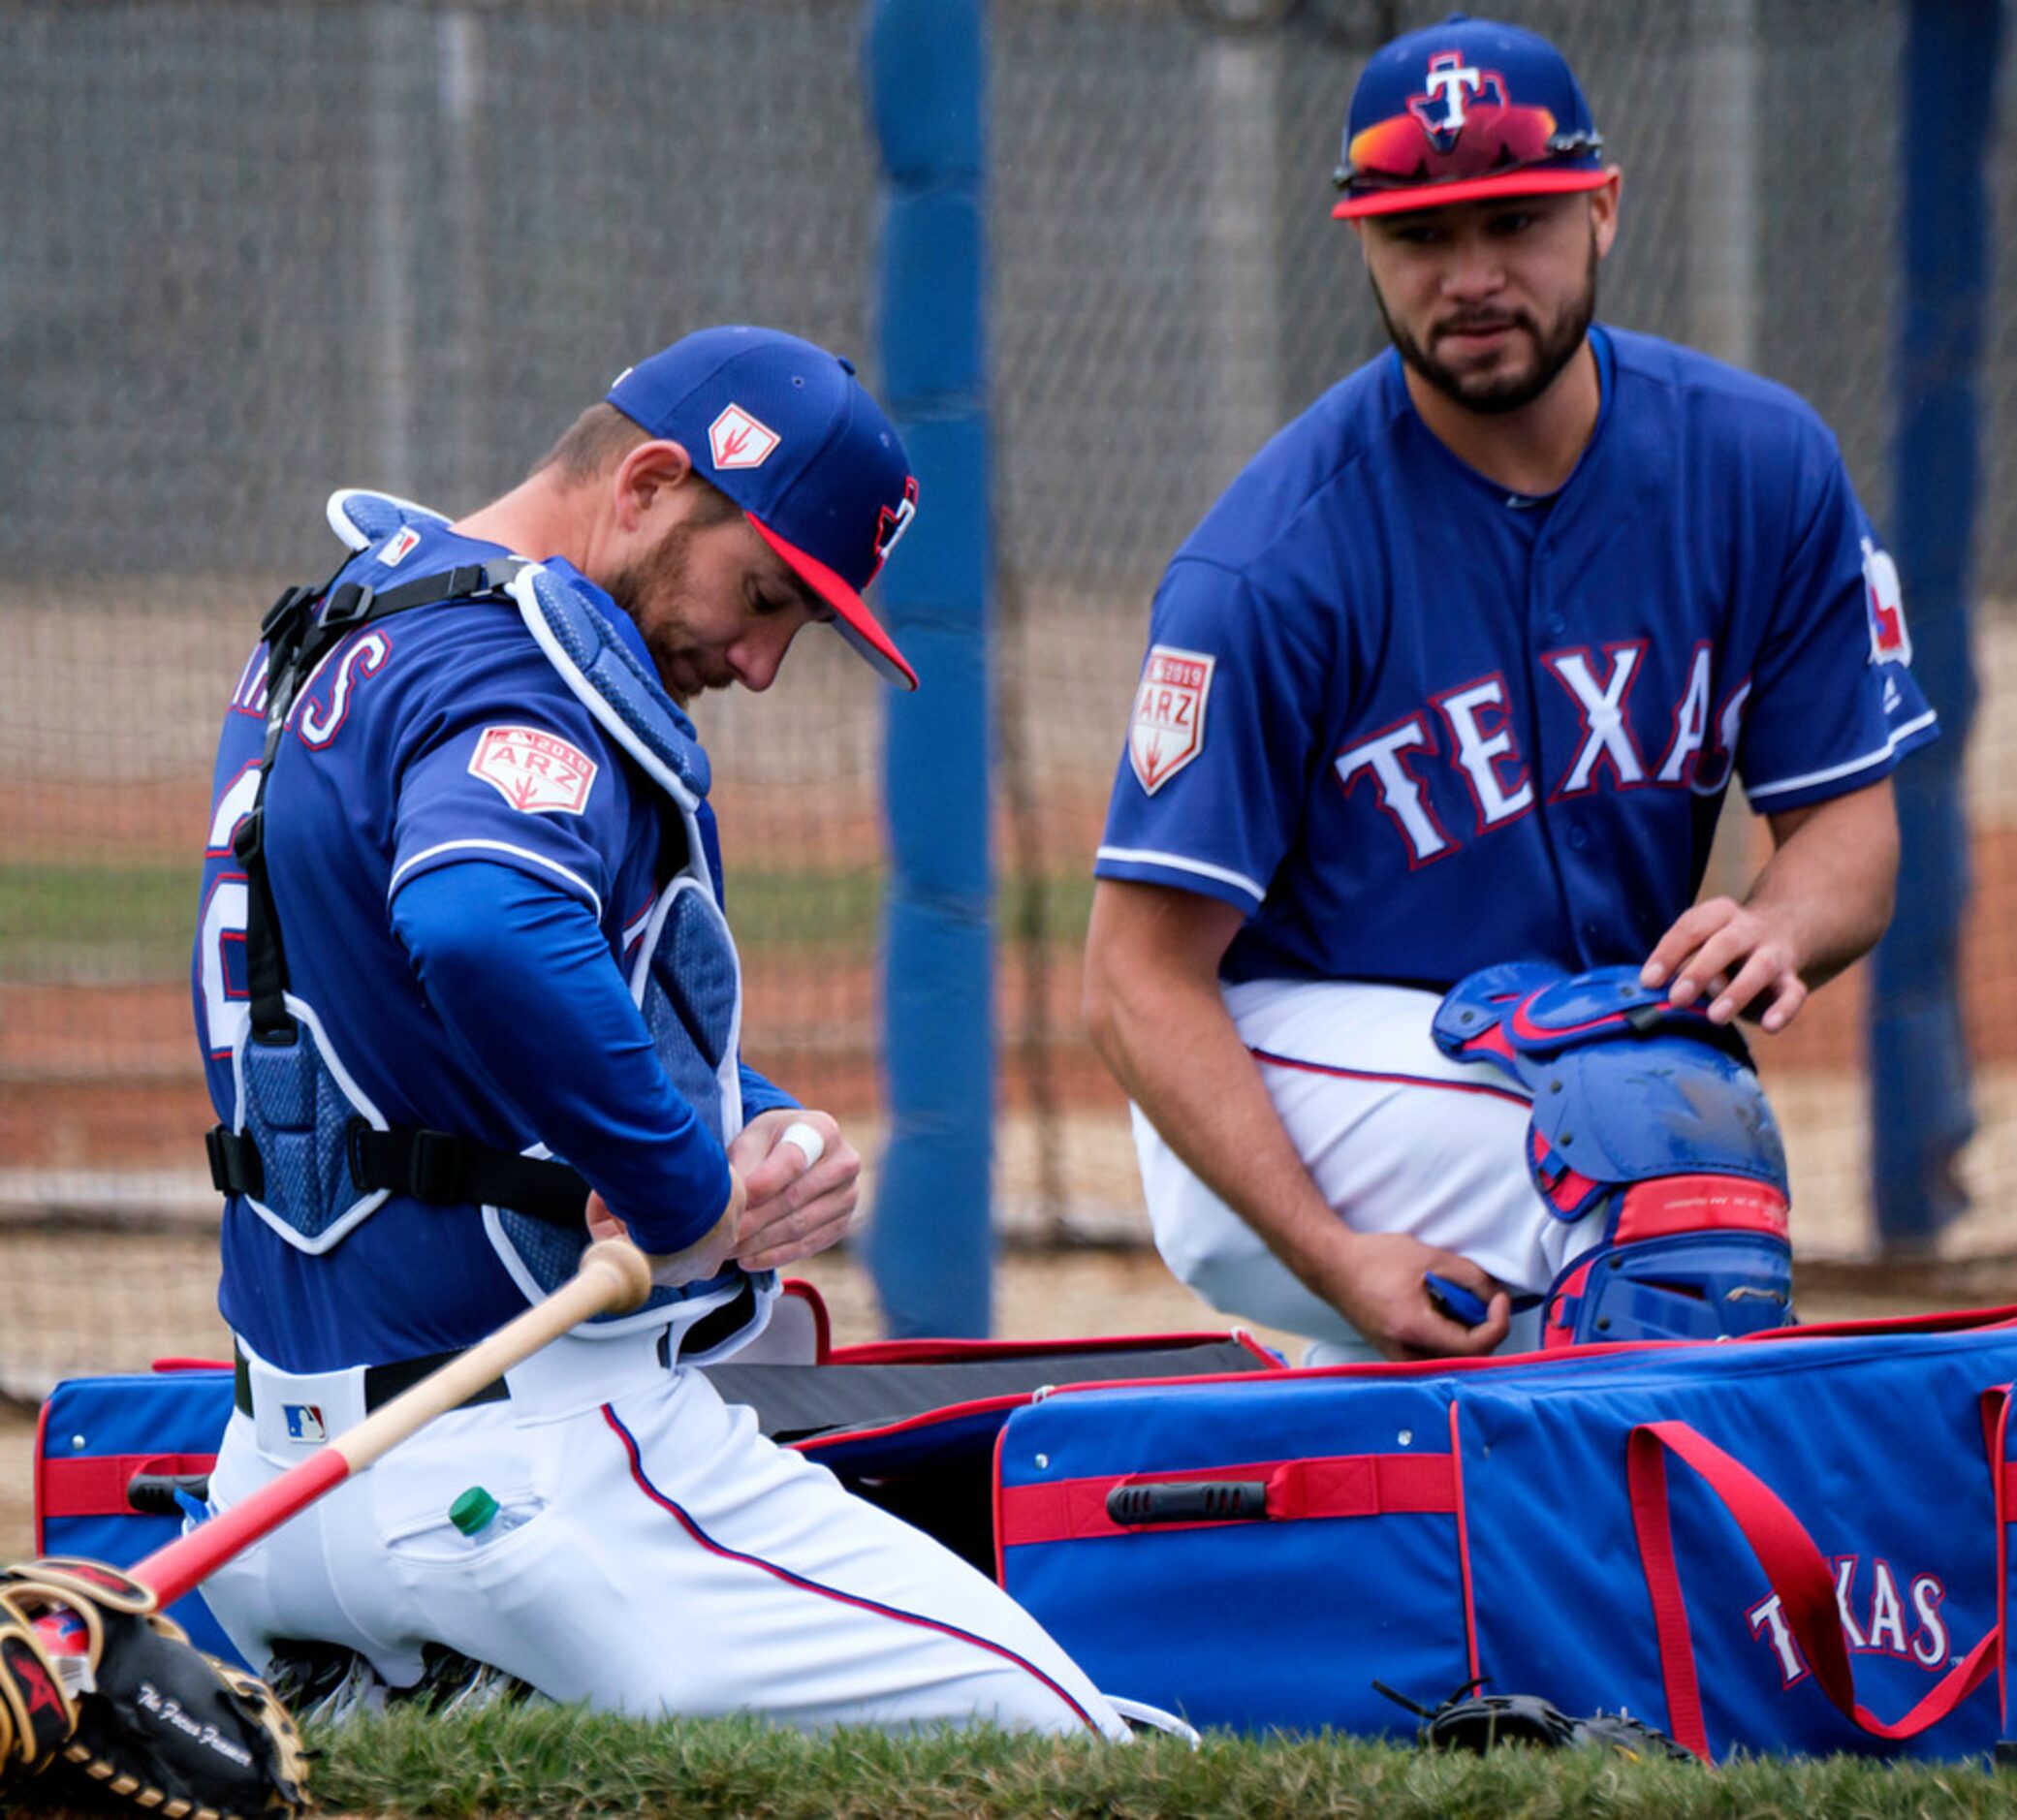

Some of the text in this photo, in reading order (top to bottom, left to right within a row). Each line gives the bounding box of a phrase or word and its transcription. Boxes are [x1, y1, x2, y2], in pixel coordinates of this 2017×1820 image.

[1426, 66, 1481, 129] T
[1138, 688, 1192, 727] ARZ
[489, 745, 579, 793] ARZ
[536, 739, 589, 774] 2019
[1744, 1553, 1950, 1691] TXAS
[138, 1682, 163, 1713] The
